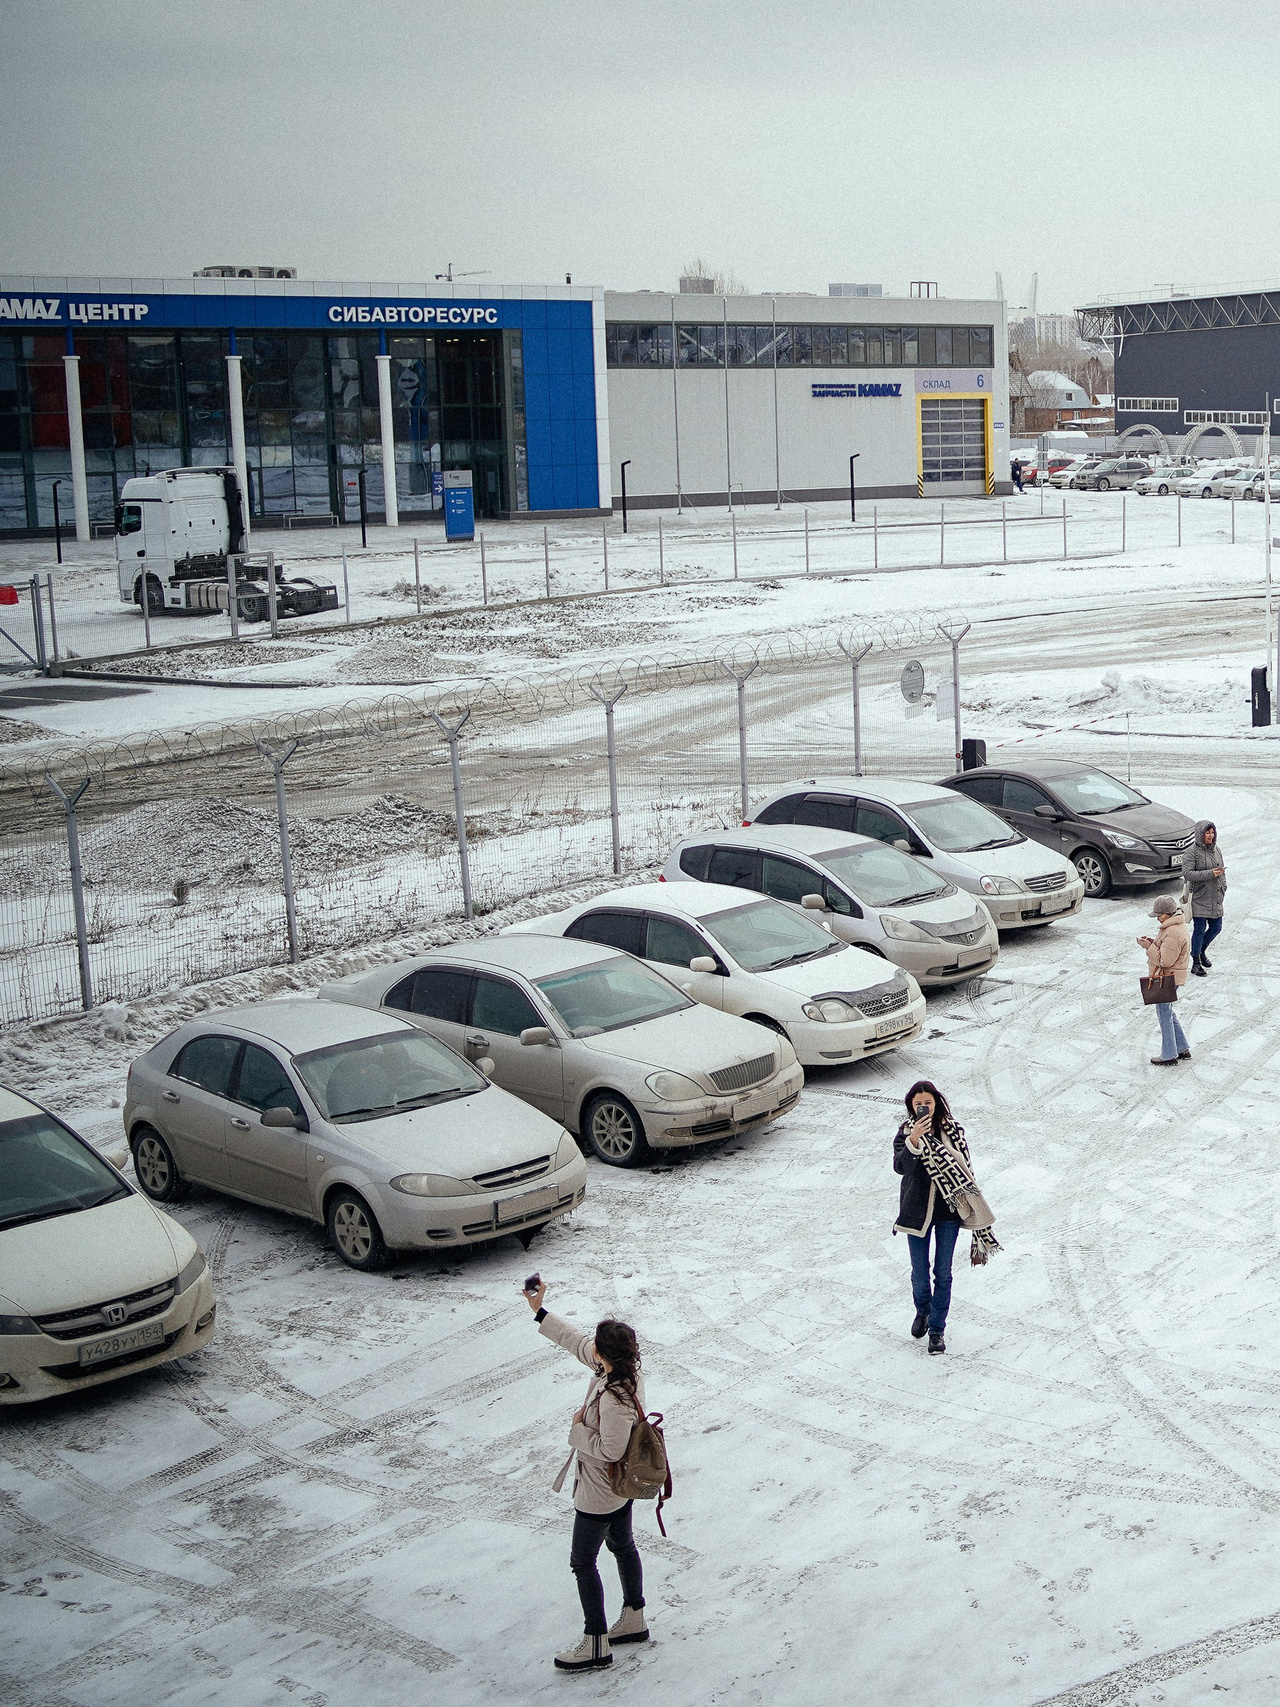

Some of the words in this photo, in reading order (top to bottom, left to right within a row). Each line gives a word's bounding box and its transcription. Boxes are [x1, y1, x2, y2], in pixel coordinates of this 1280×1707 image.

[68, 303, 149, 323] ЦЕНТР
[328, 305, 498, 324] СИБАВТОРЕСУРС
[922, 380, 951, 390] СКЛАД
[976, 373, 985, 388] 6
[811, 390, 857, 398] ЗАПЧАСТИ
[858, 383, 902, 397] KAMAZ
[139, 1325, 159, 1340] 154
